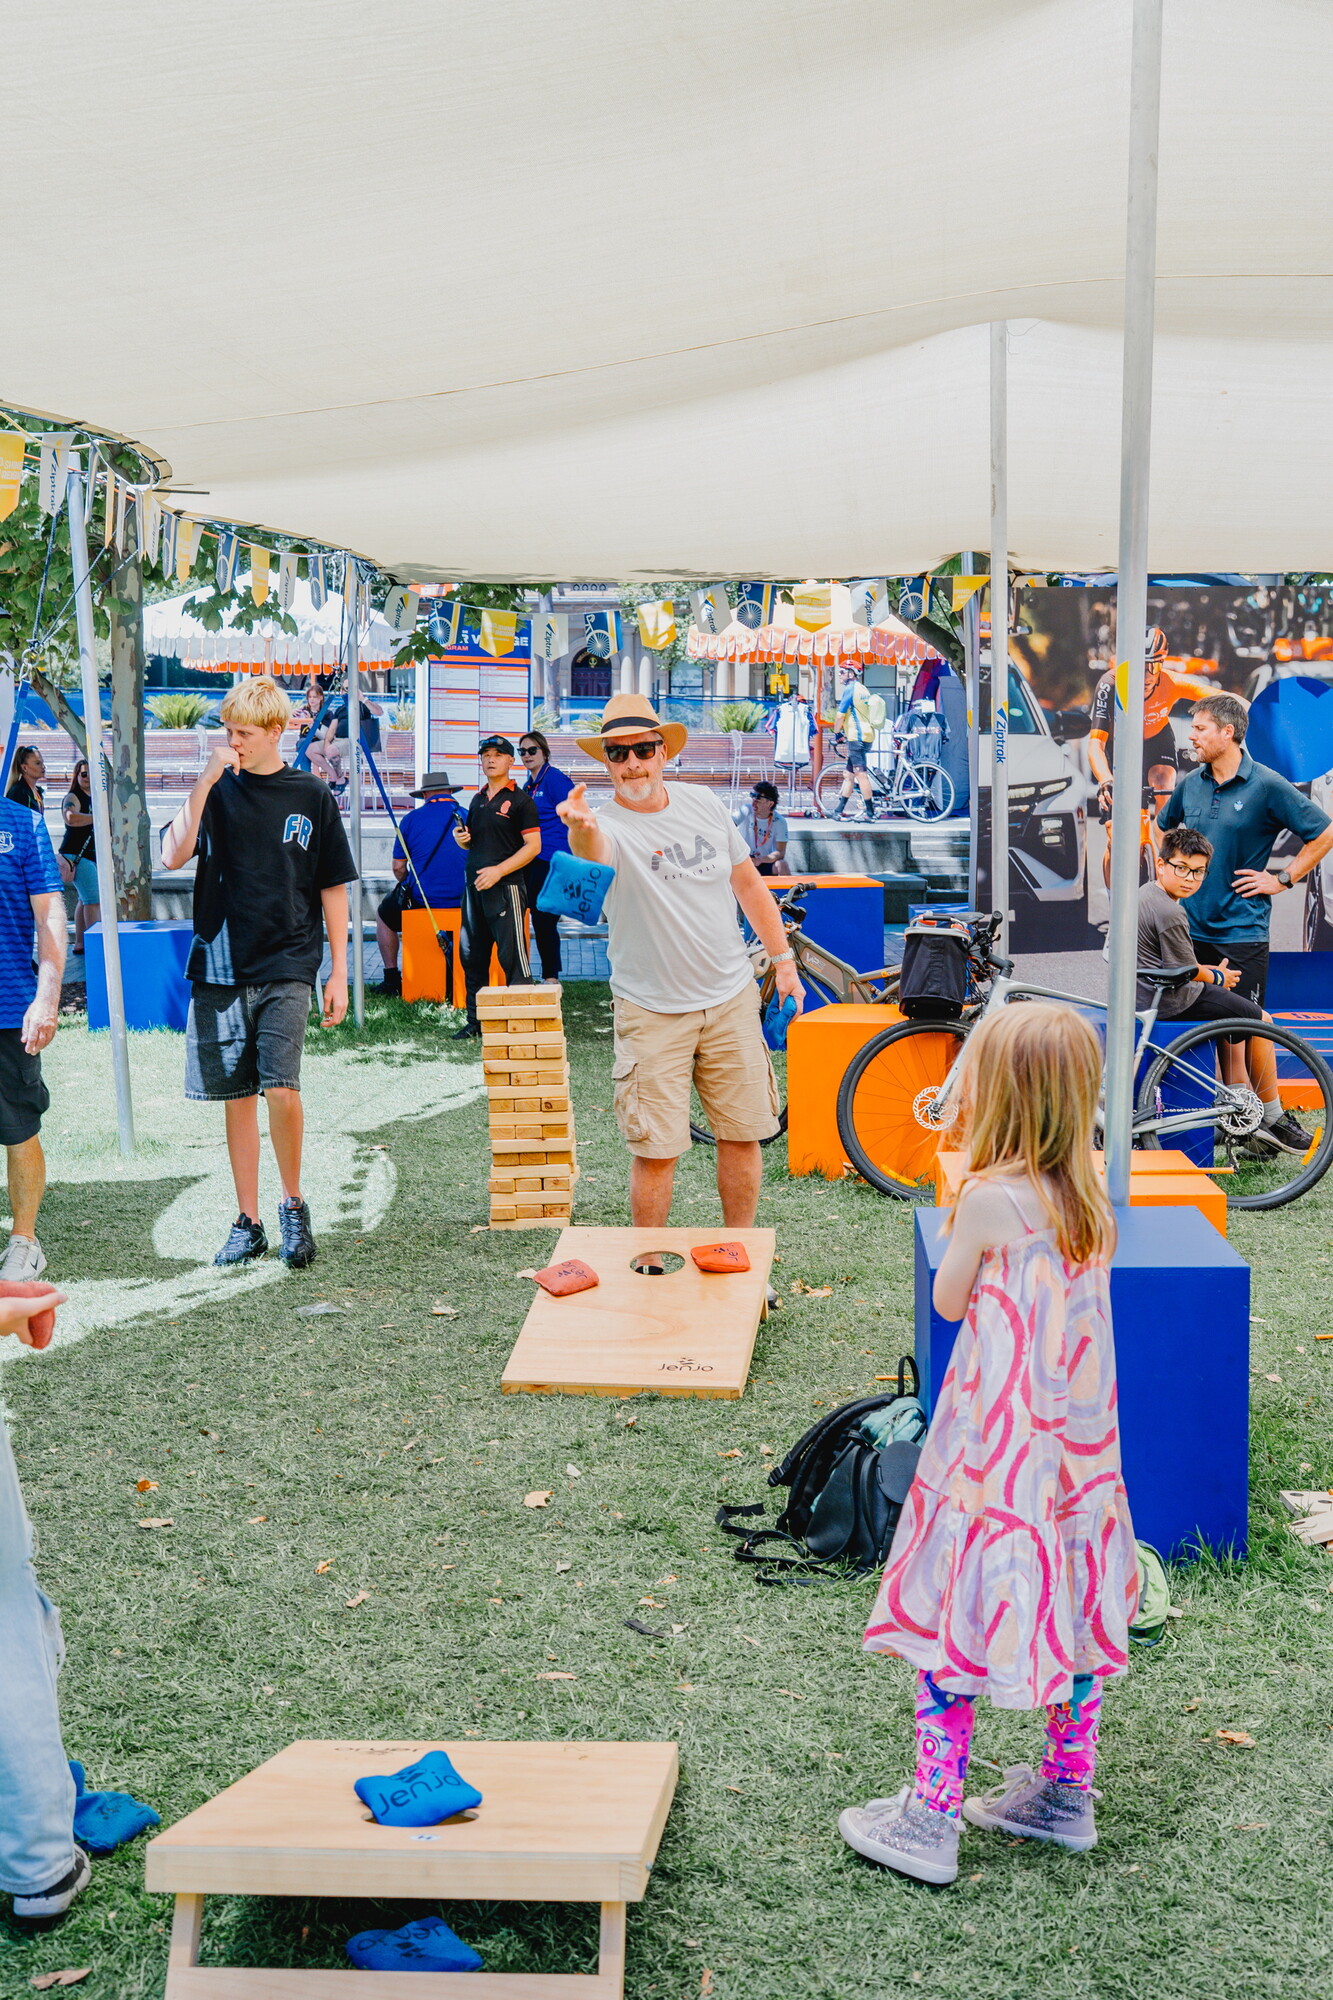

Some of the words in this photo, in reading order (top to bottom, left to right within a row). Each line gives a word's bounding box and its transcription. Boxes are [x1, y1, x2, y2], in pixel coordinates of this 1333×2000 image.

[49, 463, 57, 511] Ziptrak
[394, 603, 403, 629] Ziptrak
[864, 599, 874, 627] Ziptrak
[543, 631, 553, 659] Ziptrak
[1096, 682, 1111, 719] INEOS
[994, 720, 1006, 764] Ziptrak
[283, 814, 313, 851] FR
[651, 834, 717, 872] FILA
[571, 867, 602, 920] Jenjo
[658, 1363, 714, 1372] Jenjo
[378, 1771, 461, 1817] Jenjo
